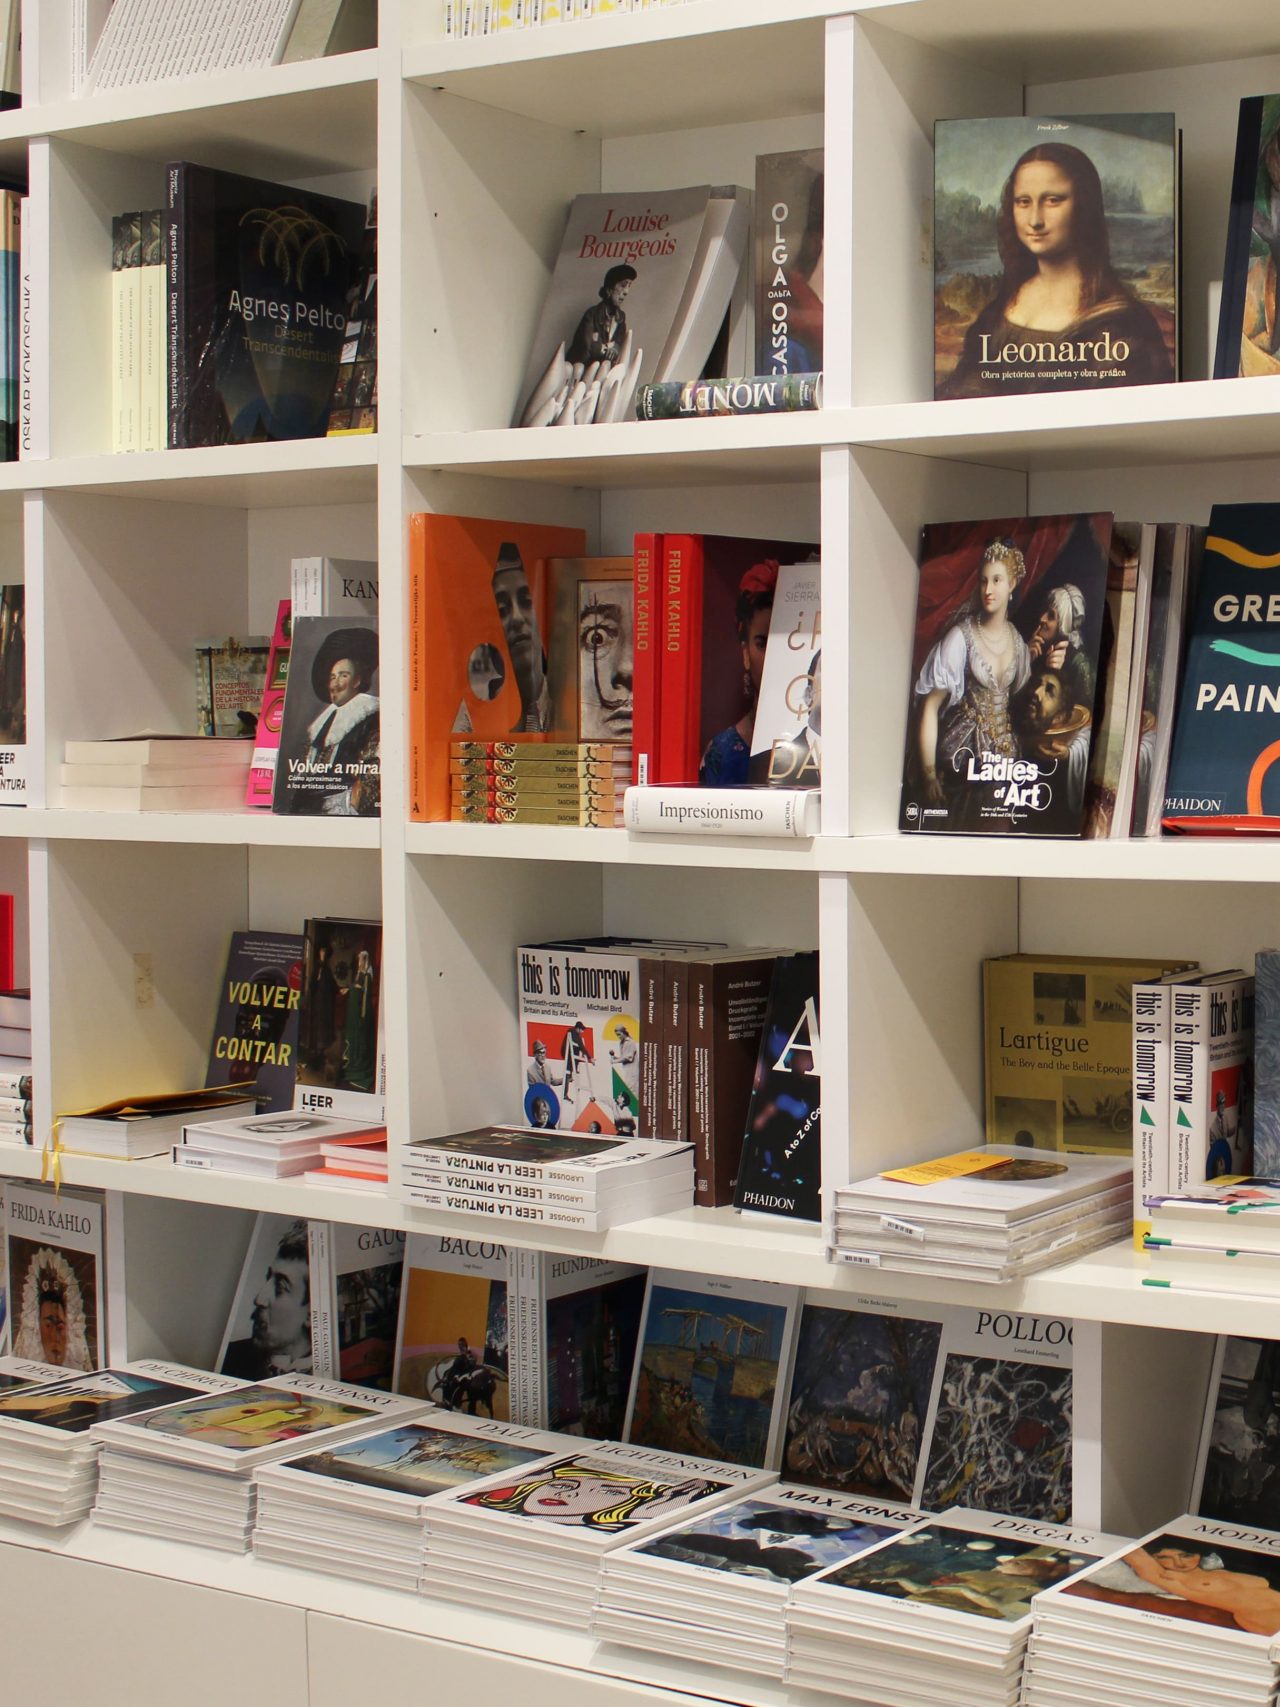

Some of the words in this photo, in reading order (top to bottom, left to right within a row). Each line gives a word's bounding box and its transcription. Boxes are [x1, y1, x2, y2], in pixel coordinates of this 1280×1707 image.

[603, 208, 668, 233] Louise
[171, 223, 179, 251] Agnes
[577, 234, 677, 263] Bourgeois
[771, 202, 788, 287] OLGA
[171, 252, 179, 284] Pelton
[229, 290, 290, 321] Agnes
[978, 332, 1130, 364] Leonardo
[981, 370, 1000, 379] Obra
[1002, 370, 1035, 381] pictórica
[1037, 369, 1073, 380] completa
[1080, 368, 1097, 378] obra
[1099, 367, 1126, 379] gráfica
[680, 382, 778, 413] MONET
[637, 549, 649, 594] FRIDA
[668, 550, 681, 595] FRIDA
[784, 590, 821, 602] SIERRA
[637, 600, 648, 650] KAHLO
[668, 600, 681, 652] KAHLO
[288, 758, 333, 775] Volver
[335, 763, 343, 774] a
[967, 757, 1039, 782] Ladies
[981, 751, 1002, 763] The
[993, 786, 1006, 799] of
[1003, 784, 1041, 807] Art
[659, 801, 764, 823] Impresionismo
[521, 953, 543, 994] this
[549, 956, 560, 995] is
[565, 957, 630, 1001] tomorrow
[229, 981, 301, 1010] VOLVER
[587, 1003, 609, 1012] Michael
[1136, 991, 1162, 1016] this
[1175, 992, 1201, 1017] this
[252, 1014, 262, 1030] A
[1210, 991, 1228, 1038] this
[1136, 1022, 1161, 1033] is
[1175, 1023, 1200, 1035] is
[216, 1036, 292, 1066] CONTAR
[1000, 1027, 1089, 1057] Lartigue
[1001, 1056, 1016, 1067] The
[1018, 1058, 1036, 1069] Boy
[1037, 1060, 1054, 1070] and
[1056, 1061, 1070, 1071] the
[1072, 1061, 1094, 1073] Belle
[1136, 1039, 1162, 1103] tomorrow
[1173, 1040, 1200, 1104] tomorrow
[302, 1093, 333, 1108] LEER
[791, 1139, 800, 1150] to
[804, 1118, 813, 1132] of
[446, 1155, 494, 1174] PINTURA
[497, 1164, 512, 1175] LA
[515, 1168, 543, 1179] LEER
[446, 1175, 495, 1193] PINTURA
[497, 1184, 512, 1196] LA
[548, 1172, 585, 1183] LAROUSSE
[446, 1196, 495, 1214] PINTURA
[514, 1187, 543, 1200] LEER
[548, 1192, 584, 1203] LAROUSSE
[743, 1191, 795, 1210] PHAIDON
[11, 1201, 45, 1225] FRIDA
[47, 1209, 92, 1235] KAHLO
[497, 1204, 512, 1216] LA
[515, 1208, 544, 1220] LEER
[548, 1213, 585, 1224] LAROUSSE
[508, 1295, 517, 1361] FRIEDENSREICH
[519, 1296, 527, 1363] FRIEDENSREICH
[161, 1365, 239, 1390] CHIRICO
[287, 1377, 401, 1407] KANDINSKY
[594, 1443, 758, 1481] LICHTENSTEIN
[778, 1490, 835, 1508] MAX
[842, 1502, 932, 1525] ERNST
[990, 1518, 1096, 1546] DEGAS
